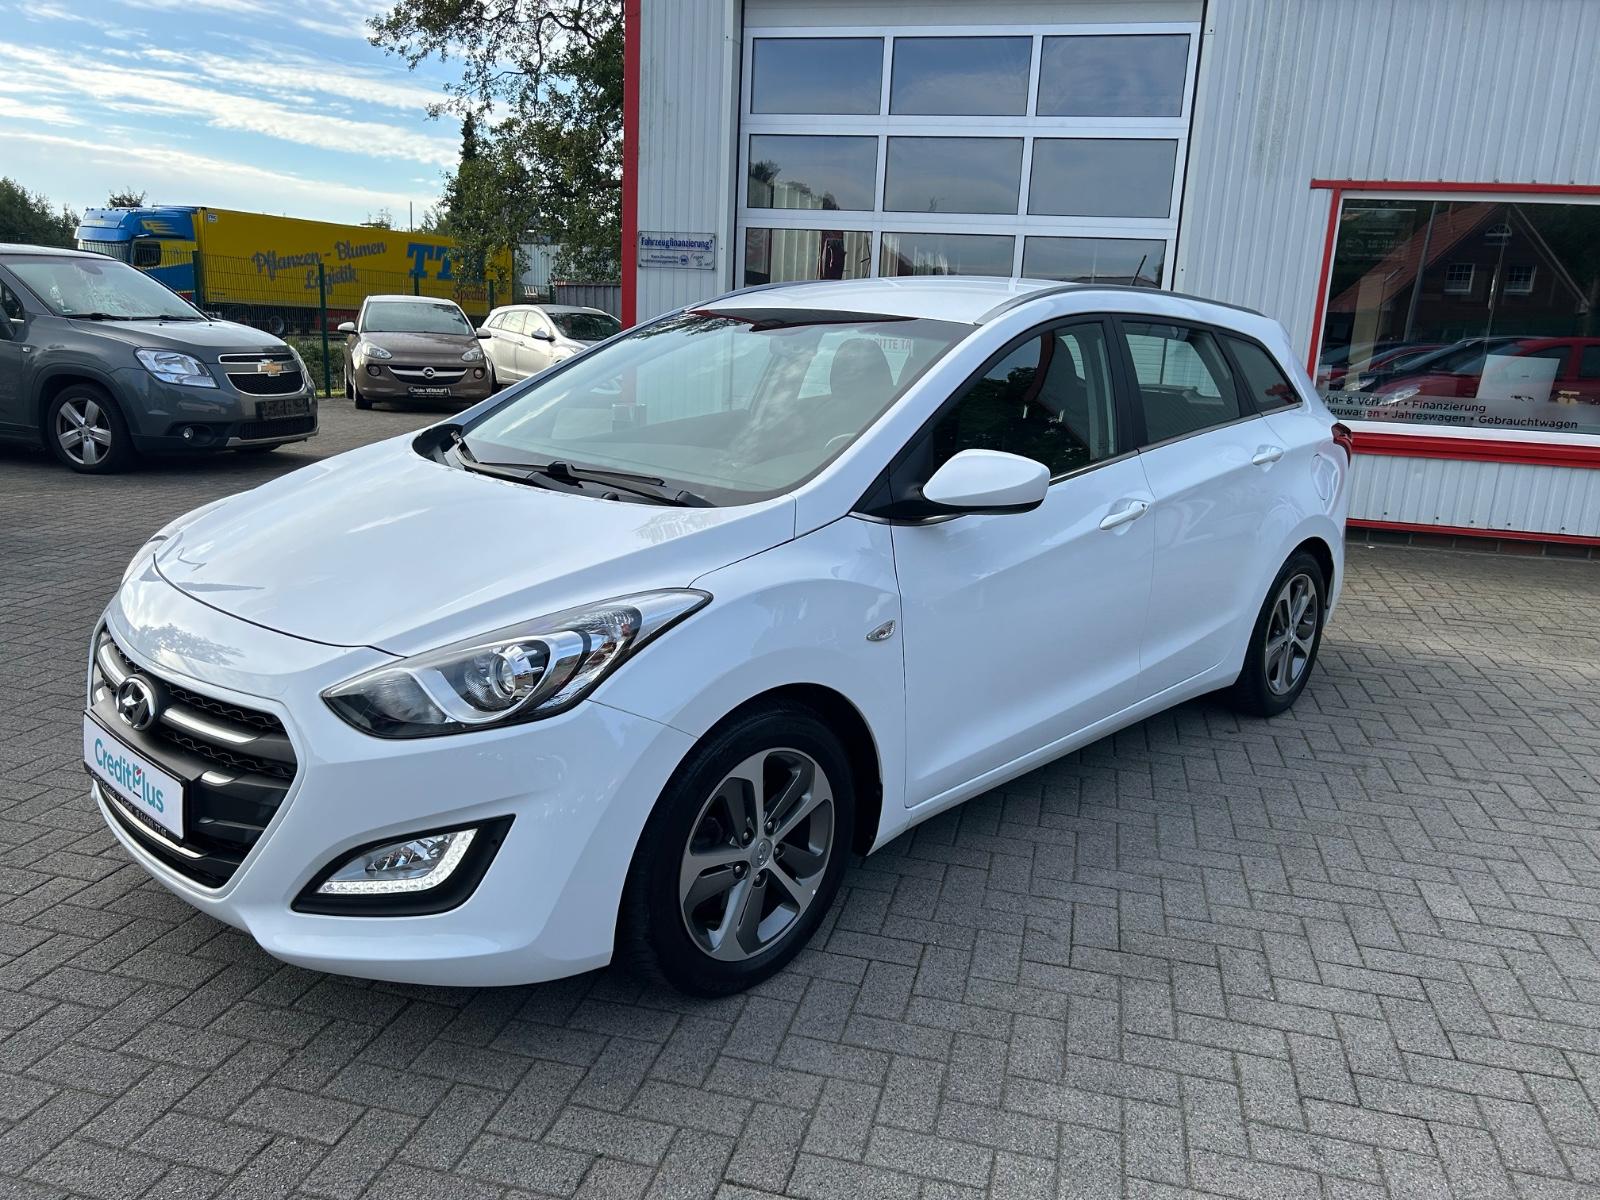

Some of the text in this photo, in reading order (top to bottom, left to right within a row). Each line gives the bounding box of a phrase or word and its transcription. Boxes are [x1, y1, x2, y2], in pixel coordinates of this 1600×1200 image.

[641, 237, 713, 250] Fahrzeugfinanzierung?
[251, 249, 321, 282] Pflanzen
[334, 240, 387, 261] Blumen
[1346, 396, 1354, 405] &
[1412, 400, 1487, 414] Finanzierung
[1391, 410, 1466, 423] Jahreswagen
[1478, 415, 1579, 430] Gebrauchtwagen
